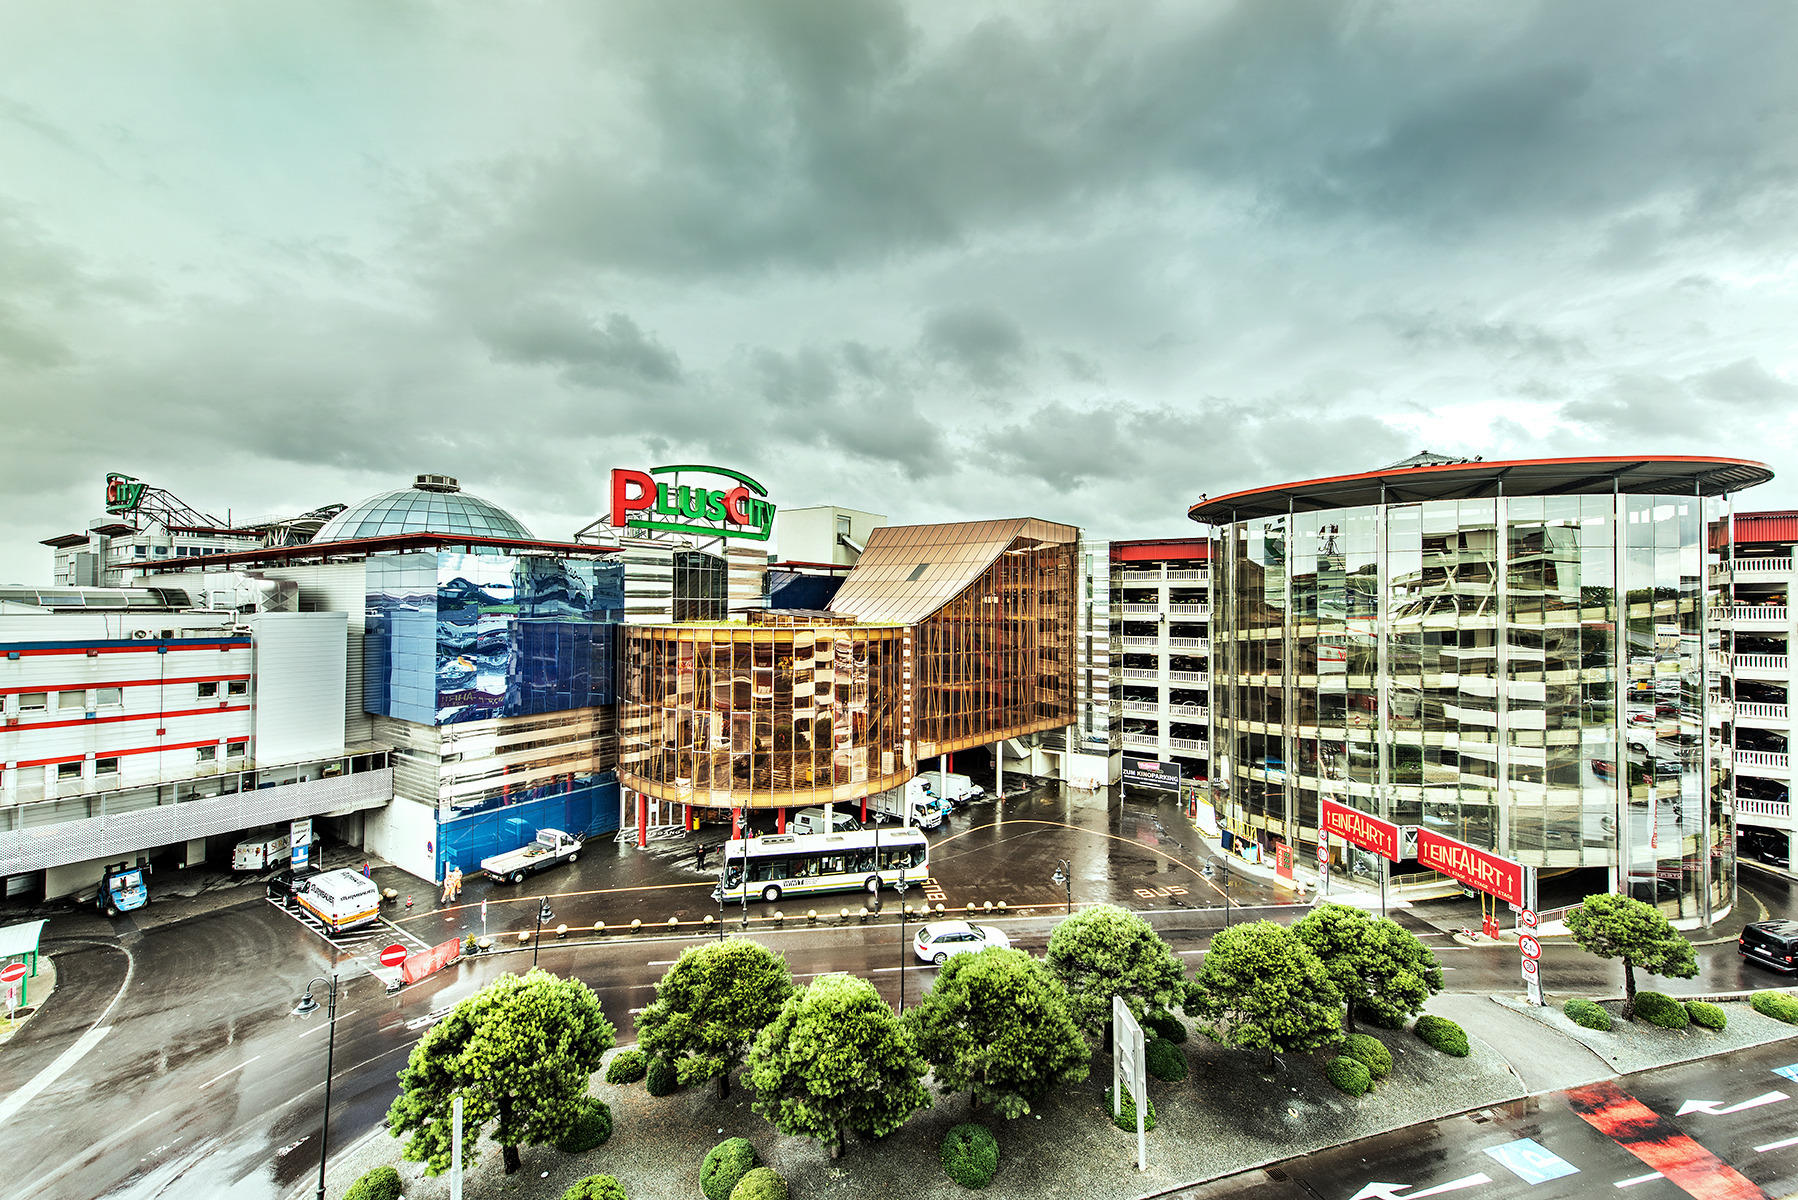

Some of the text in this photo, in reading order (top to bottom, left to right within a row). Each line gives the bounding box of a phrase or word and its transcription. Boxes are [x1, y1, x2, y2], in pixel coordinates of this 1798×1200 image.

[1137, 771, 1179, 783] KINOPARKING
[1331, 812, 1385, 846] EINFAHRT
[1430, 844, 1504, 887] EINFAHRT
[1133, 885, 1188, 899] BUS
[1498, 890, 1513, 900] ETAGE
